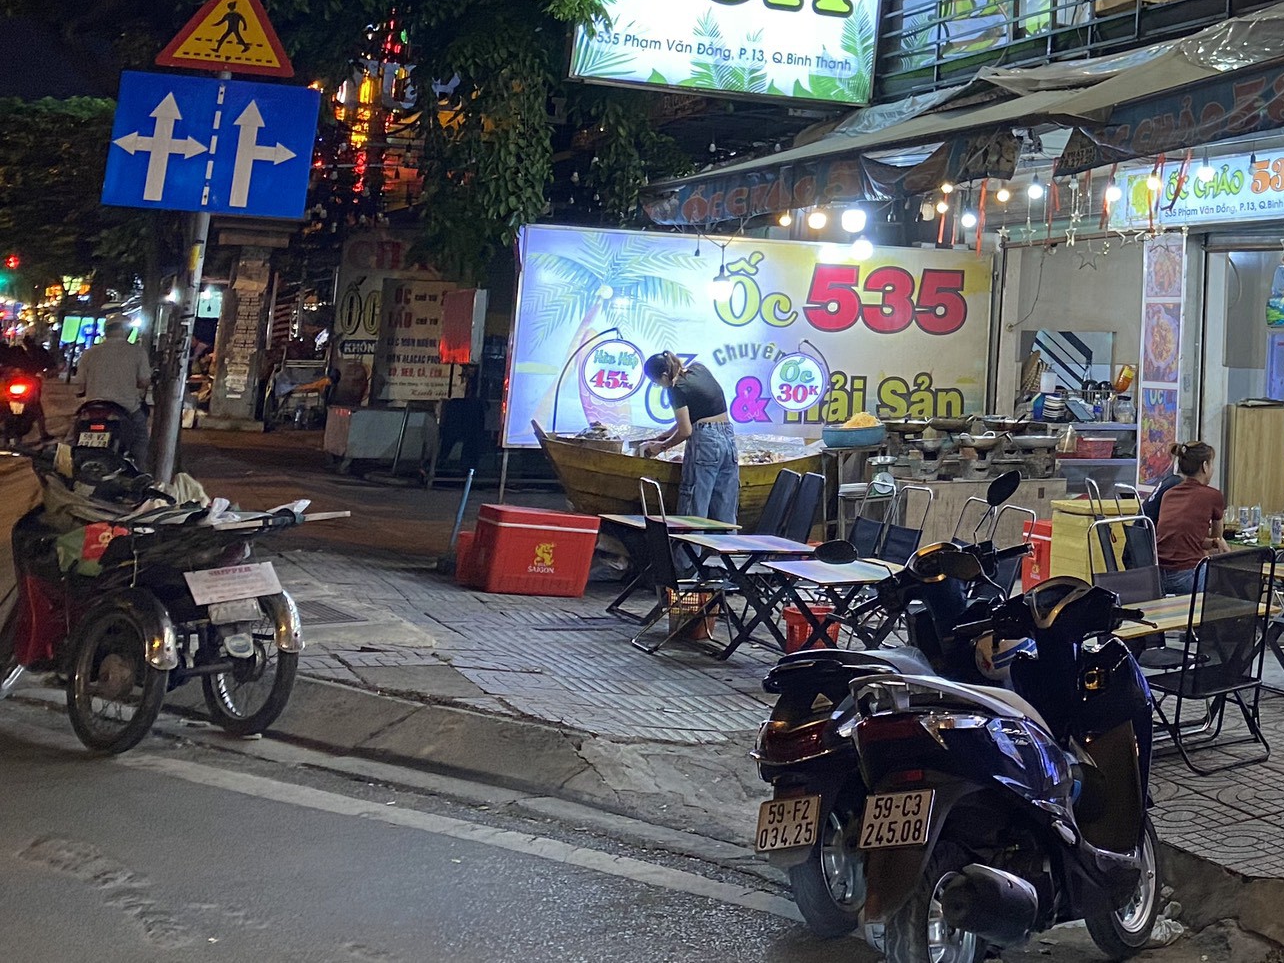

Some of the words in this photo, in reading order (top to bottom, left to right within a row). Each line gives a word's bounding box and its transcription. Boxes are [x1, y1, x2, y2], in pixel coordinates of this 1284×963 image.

[597, 31, 620, 46] 535
[624, 34, 661, 53] Phạm
[666, 39, 692, 55] Văn
[697, 40, 735, 62] Đồng,
[739, 47, 768, 64] P.13,
[816, 55, 852, 72] Thạnh
[1194, 164, 1244, 200] CHẢO
[1178, 207, 1198, 219] Phạm
[1199, 204, 1215, 215] Văn
[713, 250, 798, 327] Ốc
[802, 263, 968, 336] 535
[780, 358, 816, 383] Ốc
[730, 376, 773, 424] &
[876, 372, 965, 420] Sản
[777, 384, 819, 403] 30K
[527, 565, 555, 574] SAIGON
[767, 798, 811, 825] 59-F2
[872, 793, 922, 821] 59-C3
[759, 822, 814, 850] 034.25
[863, 817, 922, 847] 245.08
